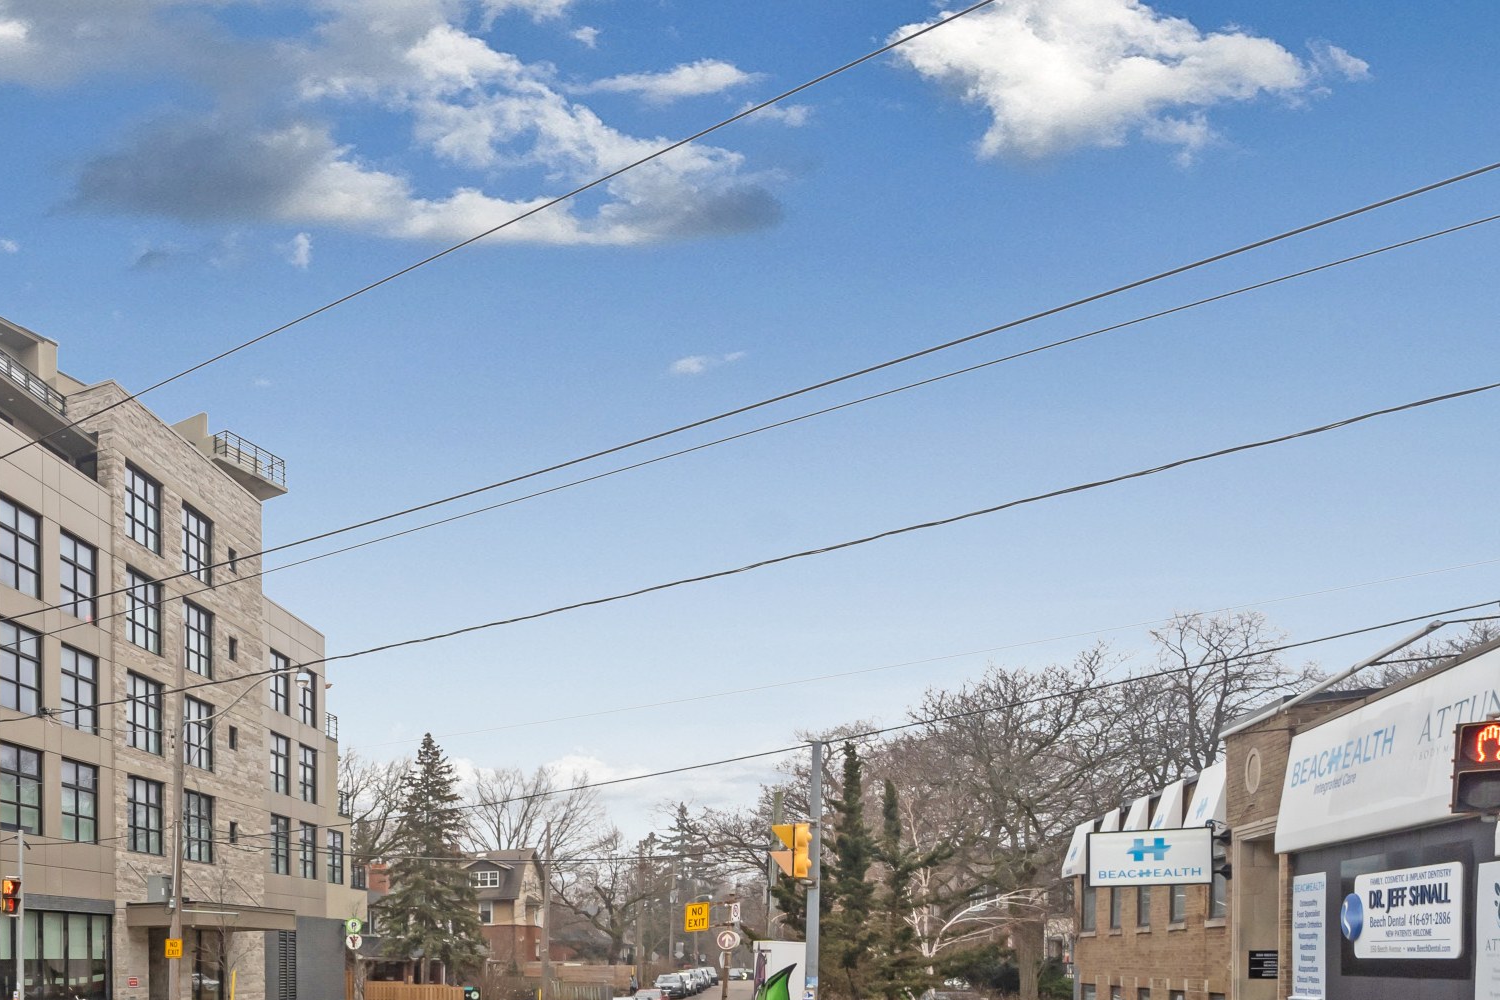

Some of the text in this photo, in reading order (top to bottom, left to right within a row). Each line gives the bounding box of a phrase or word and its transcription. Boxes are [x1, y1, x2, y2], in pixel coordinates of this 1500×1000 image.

[1290, 725, 1396, 788] BEACHEALTH
[1313, 772, 1357, 795] Integrated Care
[1098, 867, 1202, 880] BEACHEALTH
[1385, 874, 1405, 884] COSMETIC
[1410, 871, 1427, 882] IMPLANT
[1428, 868, 1452, 879] DENTISTRY
[1369, 882, 1451, 914] DR. JEFF SHNALL
[691, 906, 703, 916] NO
[688, 918, 706, 928] EXIT
[1369, 911, 1451, 928] Beech Dental 416-691-2886
[1385, 928, 1432, 938] NEW PATIENTS WELCOME
